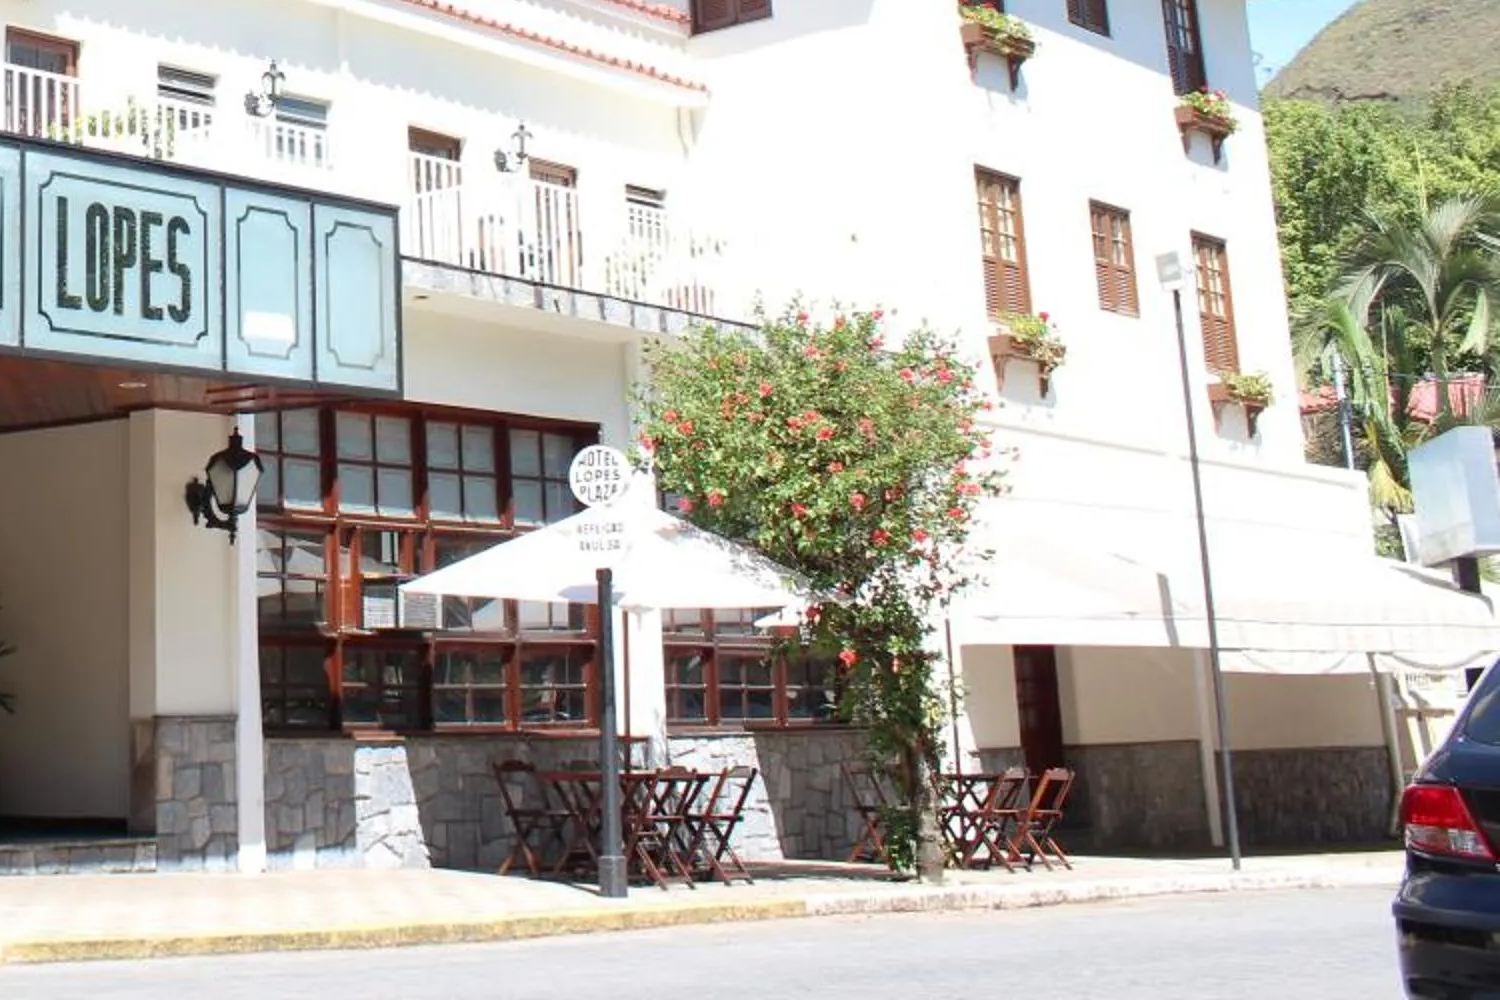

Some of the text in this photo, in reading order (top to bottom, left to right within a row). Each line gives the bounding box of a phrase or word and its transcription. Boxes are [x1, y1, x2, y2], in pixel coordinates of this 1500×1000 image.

[56, 195, 192, 324] LOPES
[578, 449, 619, 467] HOTEL
[576, 468, 621, 483] LOPES
[580, 483, 618, 503] PLAZA
